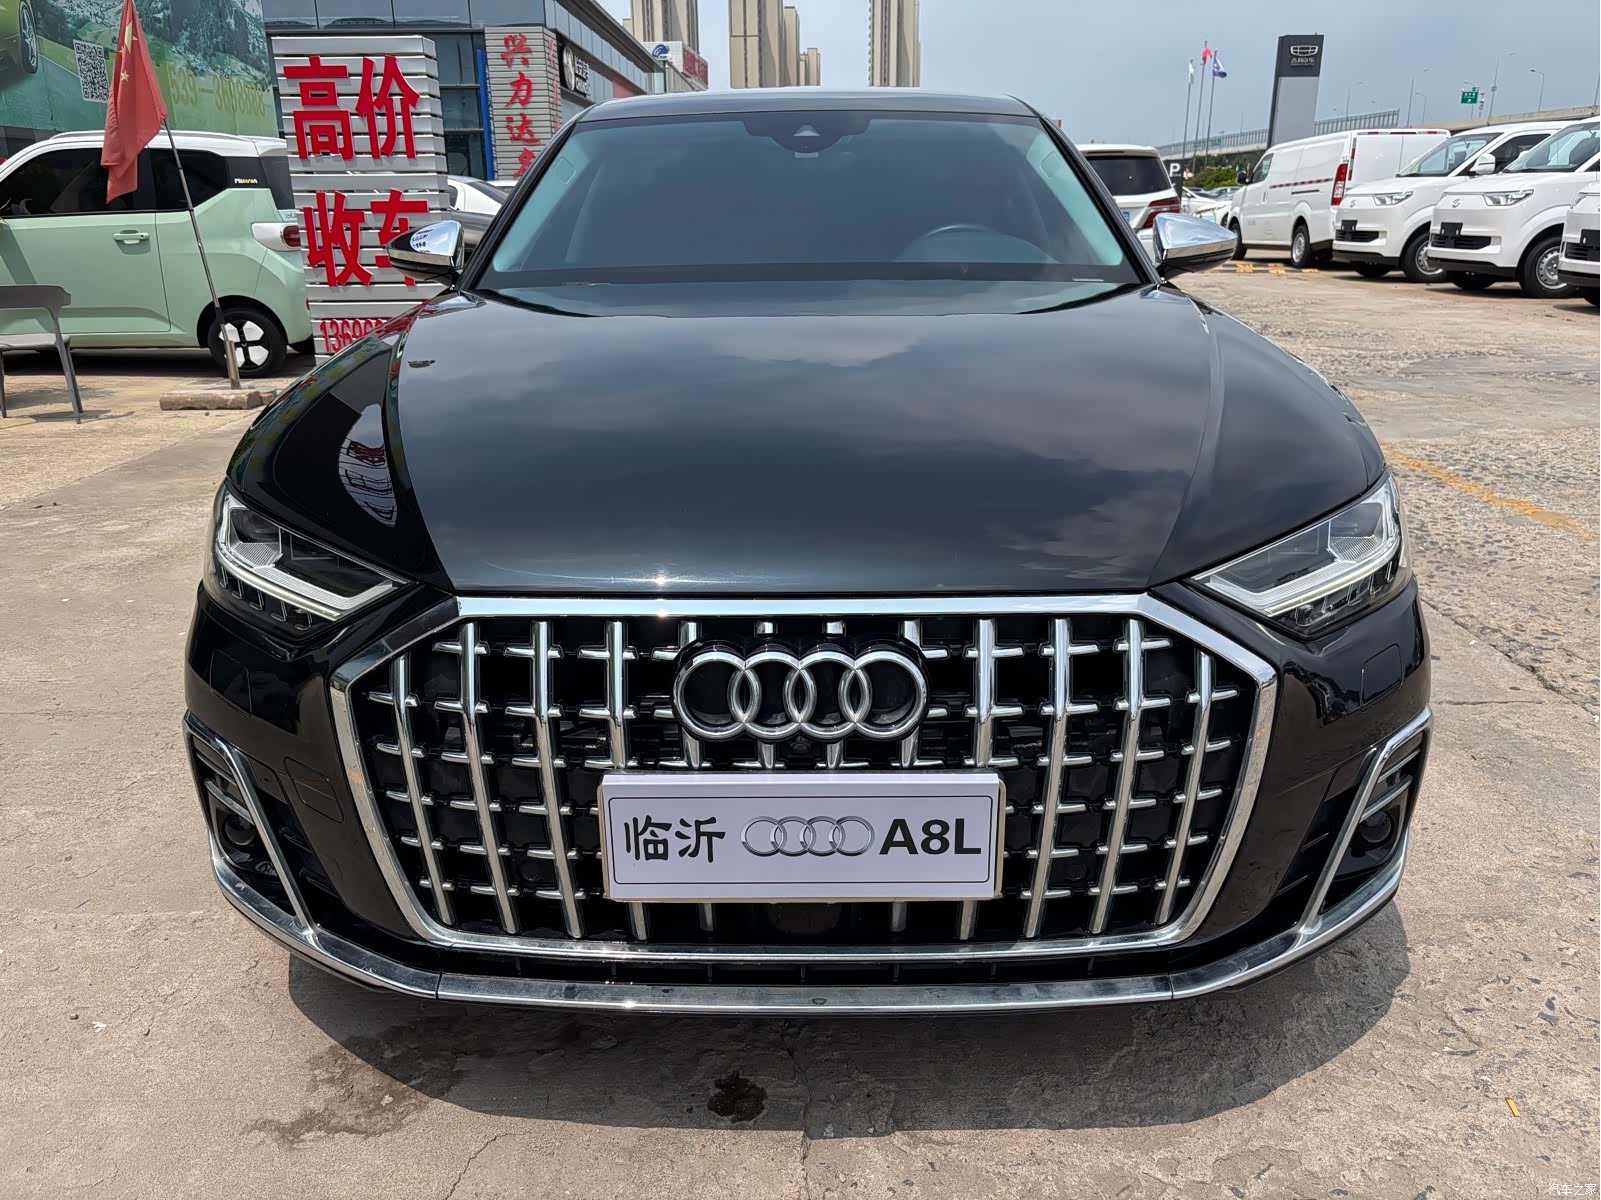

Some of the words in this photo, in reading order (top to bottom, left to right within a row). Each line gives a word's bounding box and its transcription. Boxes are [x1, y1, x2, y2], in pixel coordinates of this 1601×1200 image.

[283, 55, 420, 160] 高价
[1169, 162, 1181, 177] P
[623, 813, 726, 864] 临沂
[878, 817, 982, 856] A8L
